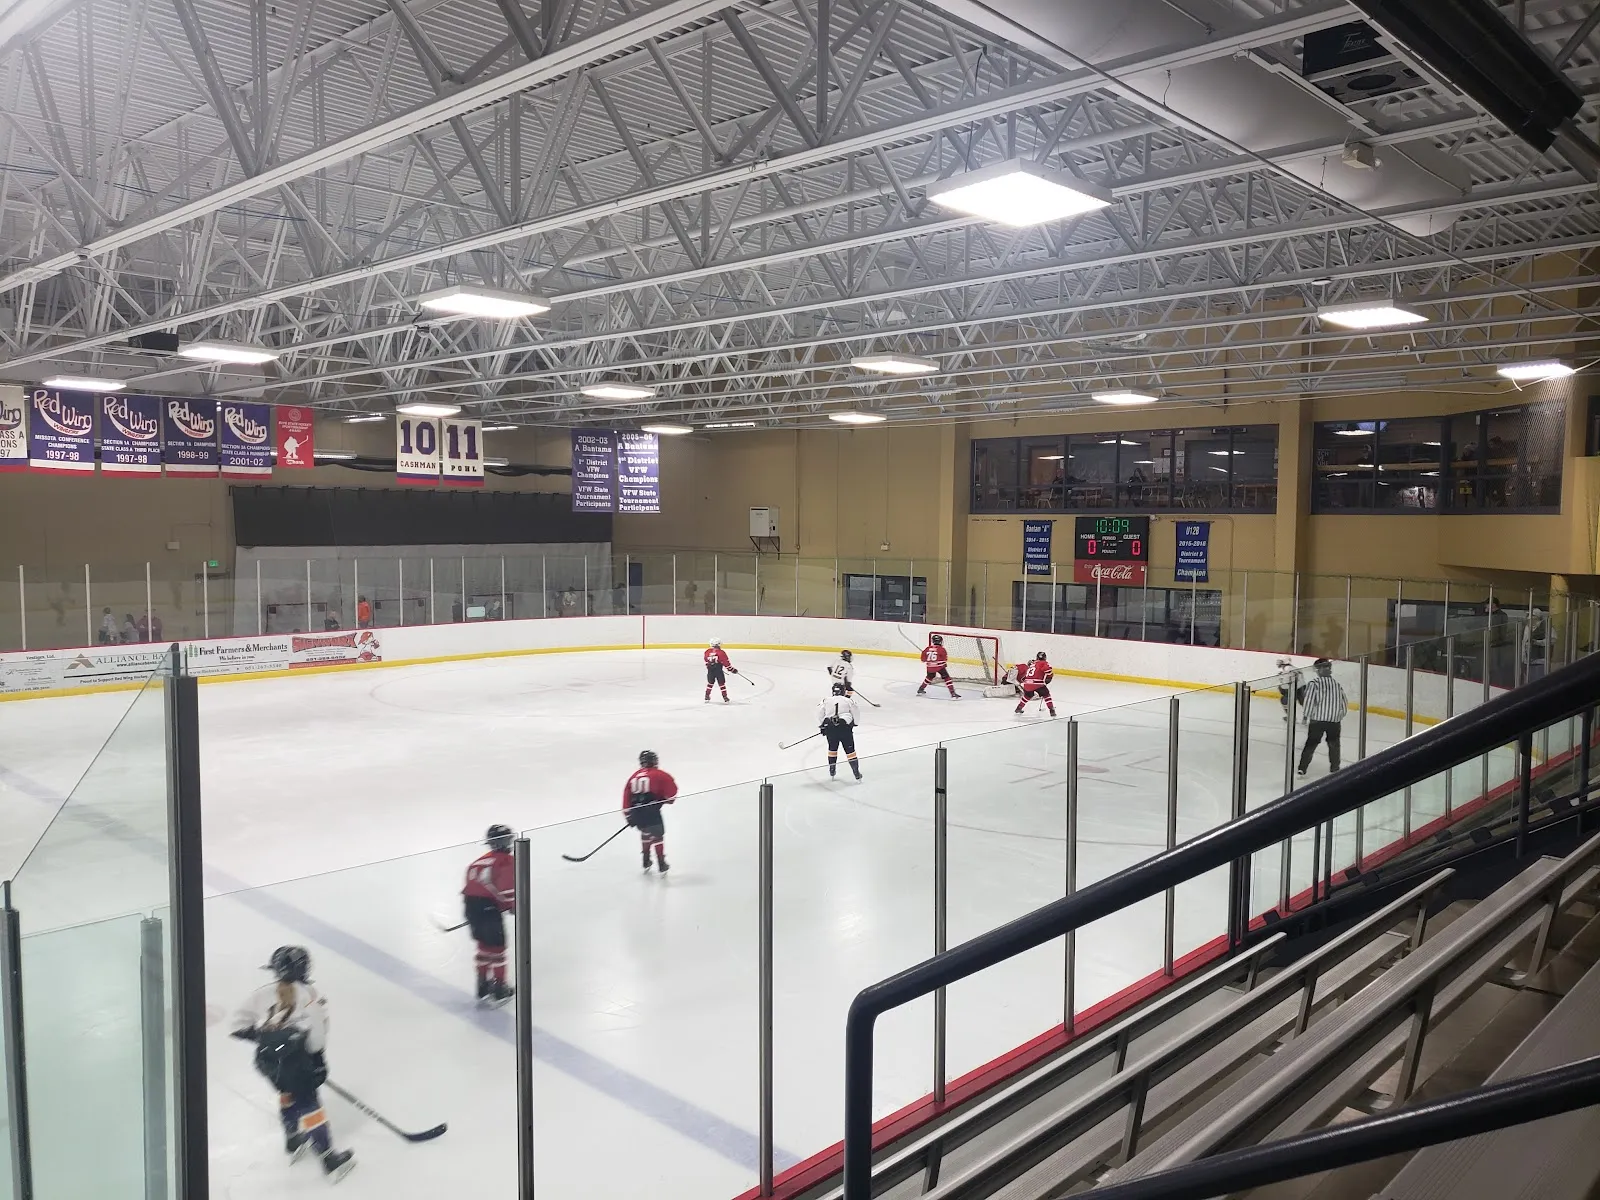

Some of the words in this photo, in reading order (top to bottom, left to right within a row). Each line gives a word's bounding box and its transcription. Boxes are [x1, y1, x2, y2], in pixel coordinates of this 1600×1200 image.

[34, 389, 60, 414] Red
[62, 405, 92, 429] Wing
[104, 396, 129, 420] Red
[130, 410, 158, 433] Wing
[168, 401, 190, 421] Red
[190, 413, 214, 433] Wing
[225, 407, 244, 427] Red
[245, 419, 266, 438] Wing
[0, 430, 15, 439] ASS
[401, 420, 436, 456] 10
[578, 435, 609, 444] 2002-03
[0, 440, 18, 448] ONS
[58, 436, 90, 444] CONFERENCE
[447, 425, 479, 460] 11
[574, 444, 580, 452] A
[582, 445, 612, 453] Bantams
[618, 442, 624, 450] A
[624, 442, 659, 450] Bantams
[45, 450, 80, 461] 1997-98
[116, 453, 148, 464] 1997-98
[177, 450, 209, 460] 1998-99
[229, 457, 264, 466] 2001-02
[400, 460, 437, 470] CASHMAN
[586, 458, 608, 466] District
[451, 464, 477, 472] POHL
[628, 466, 648, 474] VFW
[576, 471, 609, 479] Champions
[618, 475, 659, 485] Champions
[575, 500, 612, 508] Participants
[619, 504, 660, 512] Participants
[1096, 519, 1129, 534] 10:09
[1088, 540, 1097, 555] 0
[1131, 540, 1141, 555] 0
[1028, 563, 1049, 571] hampion
[200, 646, 215, 656] First
[216, 645, 244, 655] Farmers
[245, 643, 252, 653] &
[252, 642, 288, 653] Merchants
[96, 655, 149, 664] ALLIANCE
[926, 651, 938, 661] 76
[834, 664, 845, 676] 12
